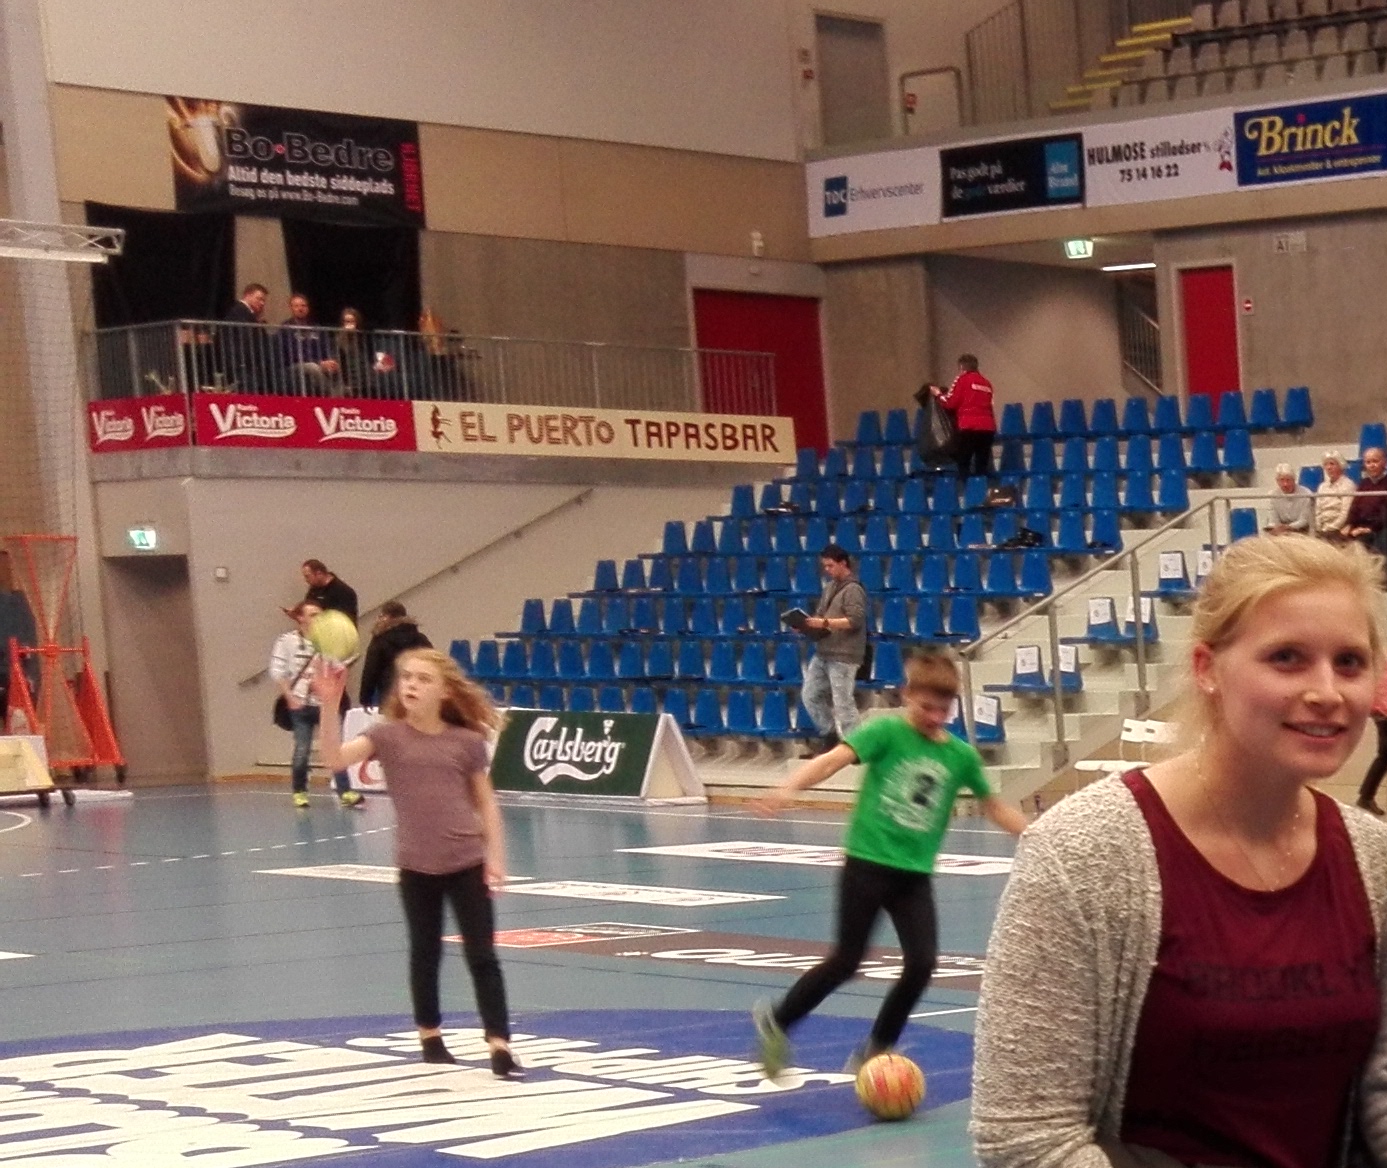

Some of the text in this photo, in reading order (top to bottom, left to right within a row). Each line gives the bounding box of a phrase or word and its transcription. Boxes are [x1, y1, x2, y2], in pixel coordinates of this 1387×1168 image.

[1243, 106, 1361, 157] Brinck
[224, 127, 396, 173] Bo Bedre
[1087, 141, 1146, 166] HULMOSE
[227, 163, 396, 197] Altid den bedste siddeplads
[1119, 163, 1180, 182] 75 14 16 22
[209, 402, 298, 434] Victoria
[314, 406, 398, 437] Victoria
[458, 410, 499, 443] EL
[624, 417, 781, 453] TAPASBAR
[522, 716, 623, 776] Carlsberg
